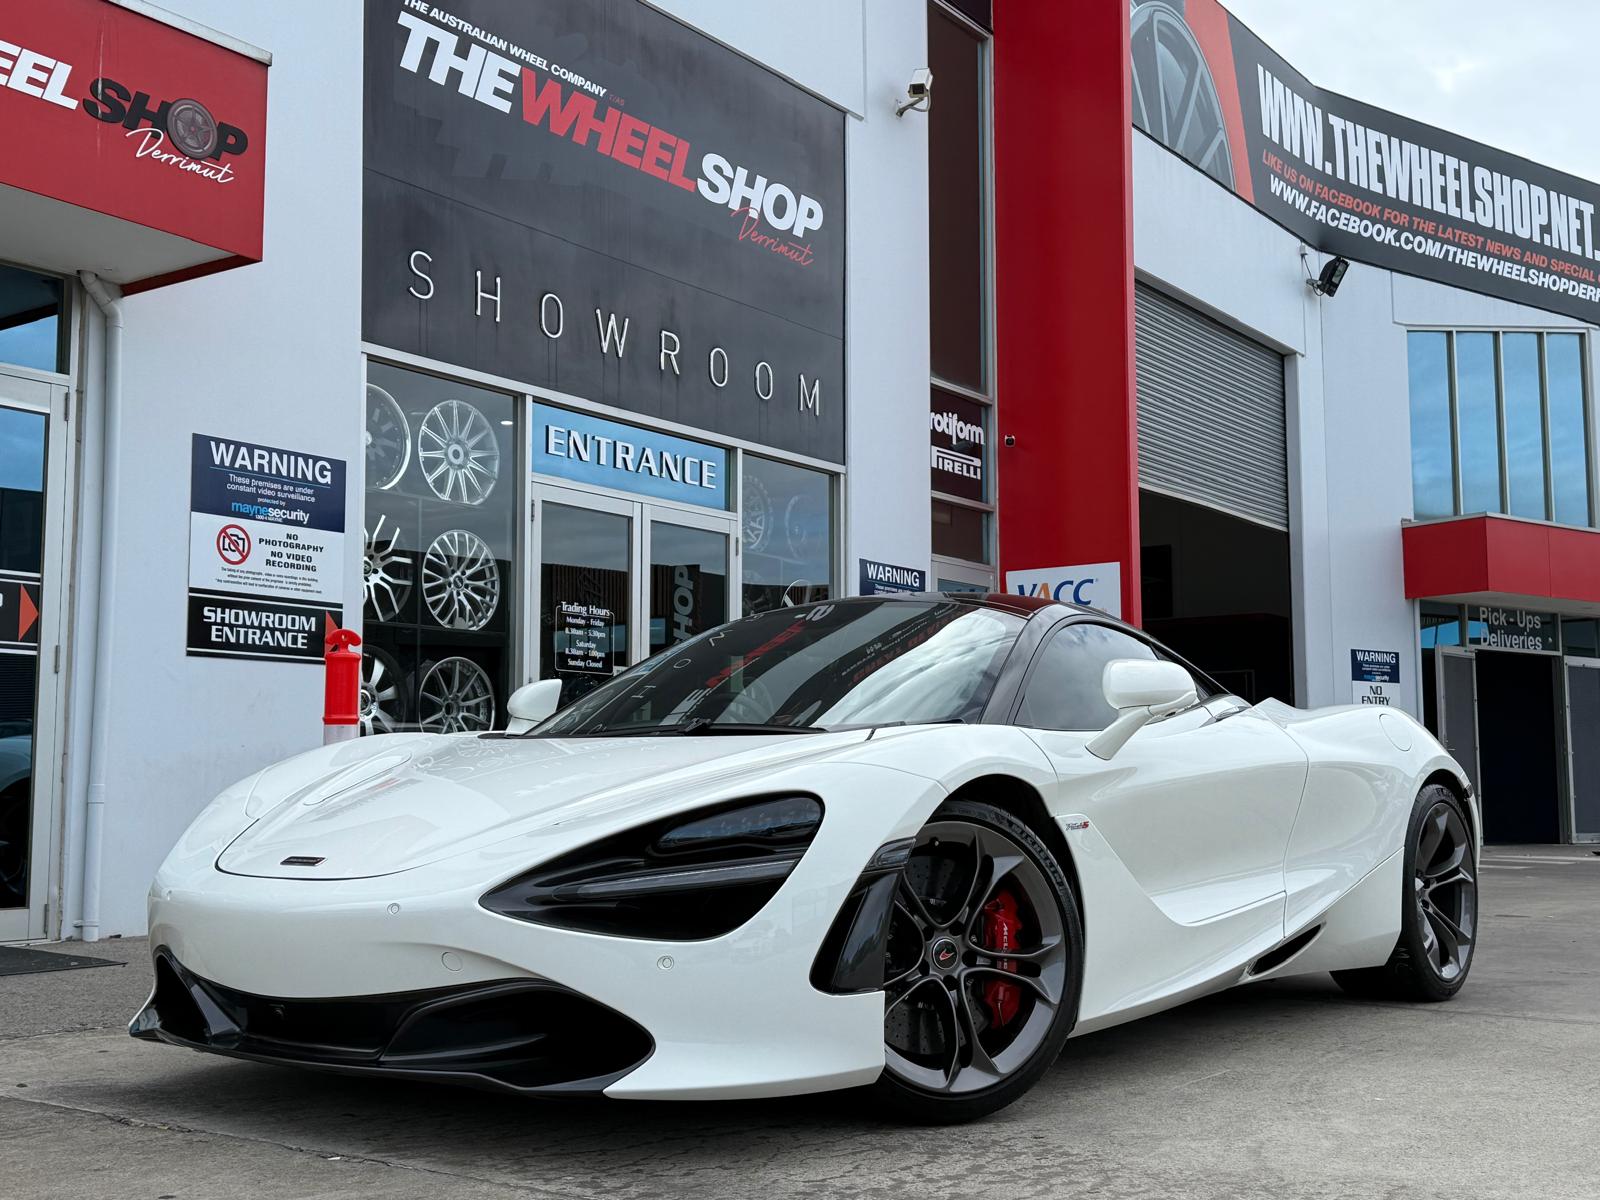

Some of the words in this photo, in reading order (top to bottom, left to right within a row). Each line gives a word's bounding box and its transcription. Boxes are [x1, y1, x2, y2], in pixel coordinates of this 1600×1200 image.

[429, 7, 508, 51] AUSTRALIAN
[509, 43, 549, 71] WHEEL
[550, 64, 607, 97] COMPANY
[397, 11, 521, 114] THE
[521, 66, 696, 192] WHEEL
[697, 153, 823, 238] SHOP
[126, 128, 234, 183] Derrimut
[1262, 149, 1282, 174] LIKE
[1283, 165, 1297, 182] US
[1299, 174, 1314, 193] ON
[1315, 183, 1382, 219] FACEBOOK
[1383, 207, 1409, 227] FOR
[1412, 217, 1435, 235] THE
[1438, 225, 1484, 249] LATEST
[1486, 239, 1521, 260] NEWS
[1523, 251, 1548, 268] AND
[1550, 260, 1595, 282] SPECIAL
[730, 206, 814, 265] Derrimut
[407, 250, 820, 416] SHOWROOM
[931, 412, 985, 445] rotiform
[210, 441, 331, 485] WARNING
[545, 424, 717, 490] ENTRANCE
[931, 445, 981, 480] PIRELLI
[227, 484, 256, 494] constant
[257, 487, 276, 497] video
[277, 491, 315, 502] surveillance
[229, 474, 250, 485] These
[251, 479, 283, 491] premises
[283, 484, 294, 492] are
[295, 486, 314, 495] under
[258, 537, 324, 553] PHOTOGRAPHY
[286, 533, 298, 541] NO
[265, 558, 317, 572] RECORDING
[270, 551, 283, 559] NO
[286, 553, 313, 563] VIDEO
[867, 562, 920, 588] WARNING
[561, 601, 587, 616] Trading
[589, 604, 610, 617] Hours
[673, 565, 694, 642] HOP
[203, 606, 316, 632] SHOWROOM
[566, 616, 586, 626] Monday
[590, 619, 605, 629] Friday
[211, 625, 308, 649] ENTRANCE
[576, 640, 597, 649] Saturday
[1480, 629, 1543, 651] Deliveries
[567, 658, 585, 668] Sunday
[586, 660, 602, 669] Closed
[1356, 650, 1396, 663] WARNING
[1361, 695, 1391, 706] ENTRY
[1369, 685, 1383, 696] NO
